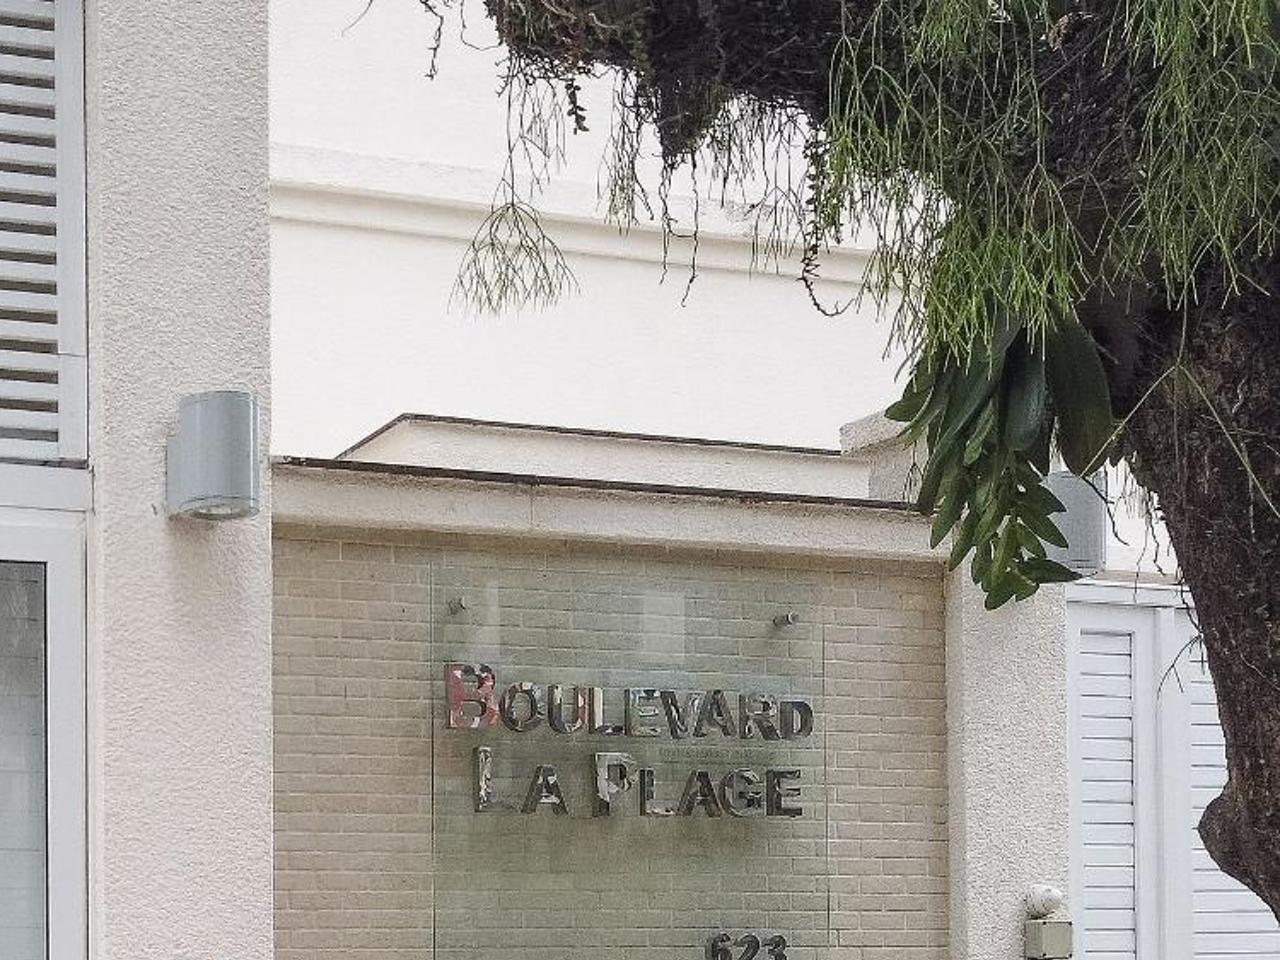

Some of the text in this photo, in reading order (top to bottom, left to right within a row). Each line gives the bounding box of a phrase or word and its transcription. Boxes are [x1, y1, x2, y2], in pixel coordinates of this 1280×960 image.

[445, 663, 814, 740] BOULEVARD
[474, 746, 803, 818] LA PLAGE
